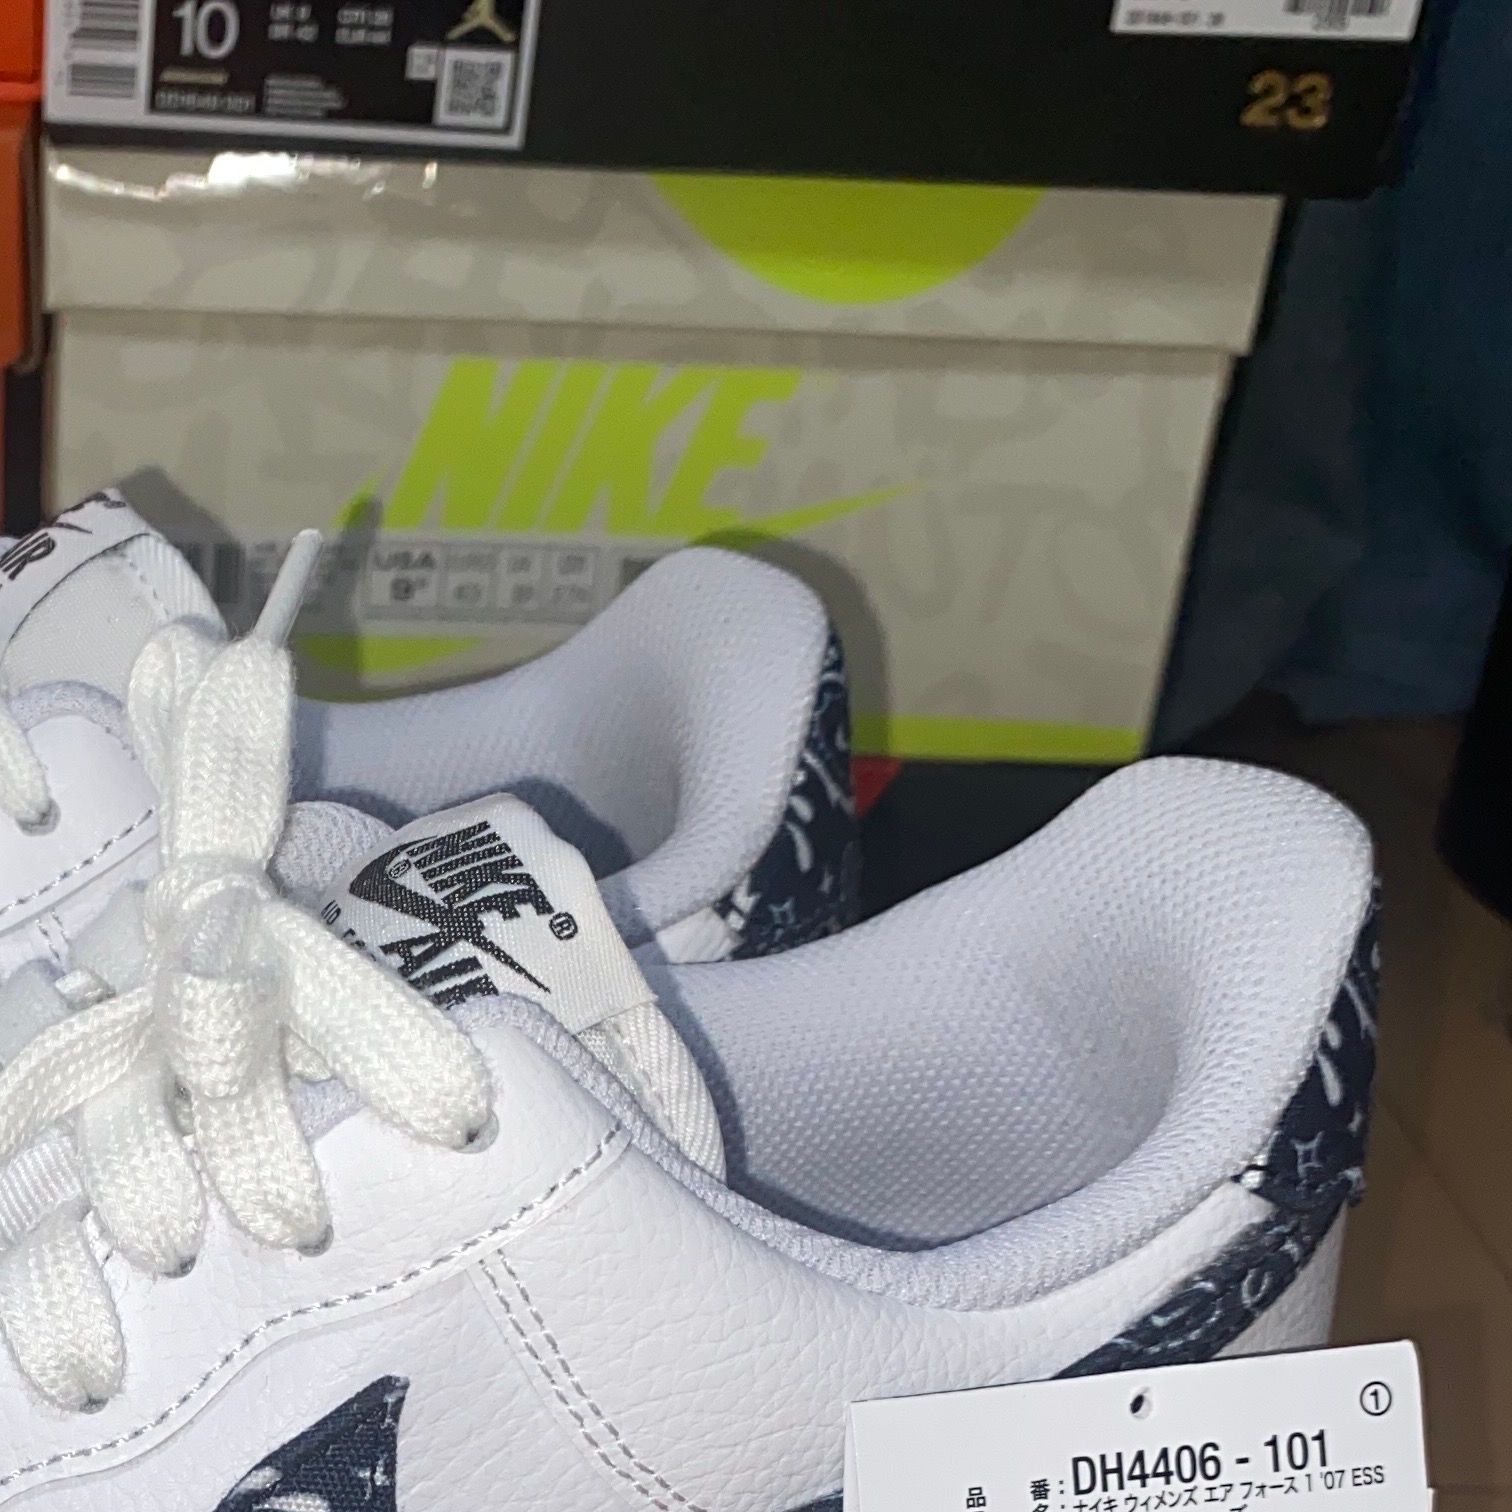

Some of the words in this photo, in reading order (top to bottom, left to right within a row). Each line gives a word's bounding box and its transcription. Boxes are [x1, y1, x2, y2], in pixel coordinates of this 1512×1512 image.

[172, 0, 240, 59] 10
[1240, 69, 1334, 130] 23
[382, 355, 802, 538] NIKE
[406, 820, 555, 916] NIKE
[1352, 1465, 1385, 1487] ESS
